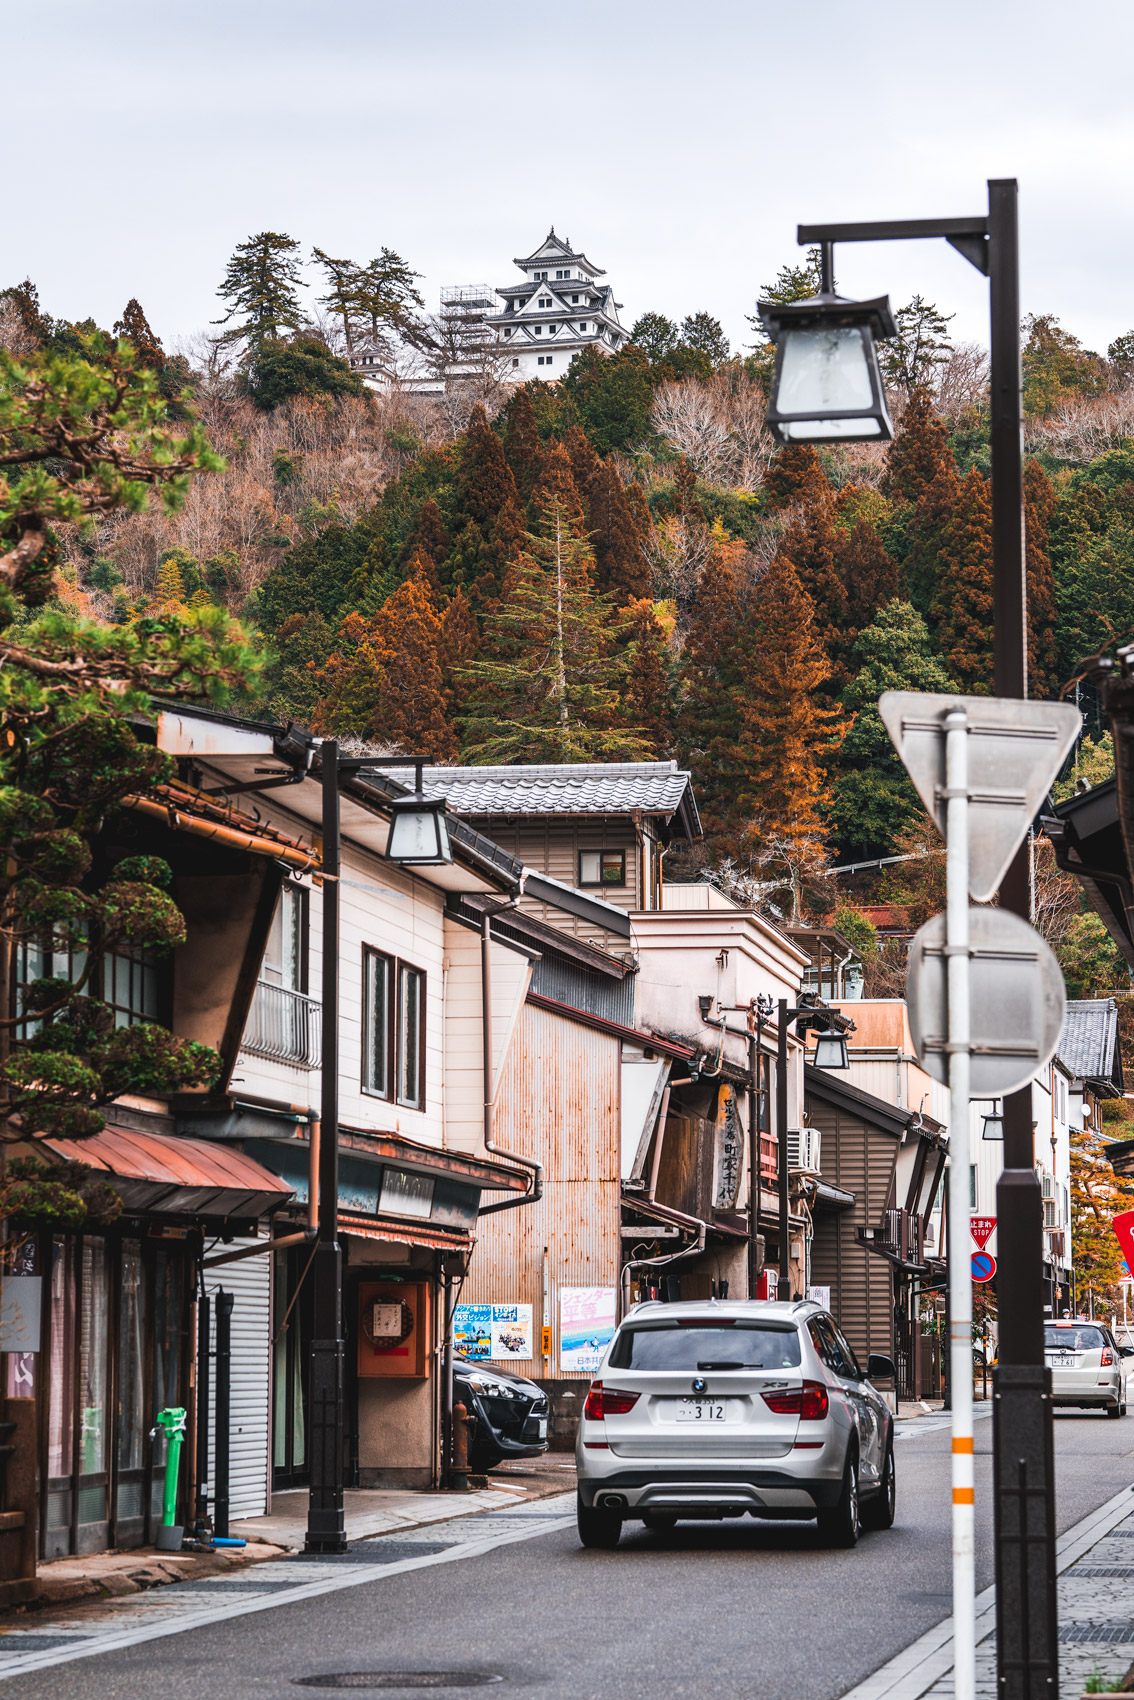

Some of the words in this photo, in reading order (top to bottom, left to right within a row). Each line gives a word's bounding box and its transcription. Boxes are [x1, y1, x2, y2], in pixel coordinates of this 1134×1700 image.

[719, 1144, 738, 1201] 町家千代
[970, 1220, 992, 1228] 止まれ
[563, 1289, 613, 1305] ジェンダー
[563, 1302, 598, 1321] 平等
